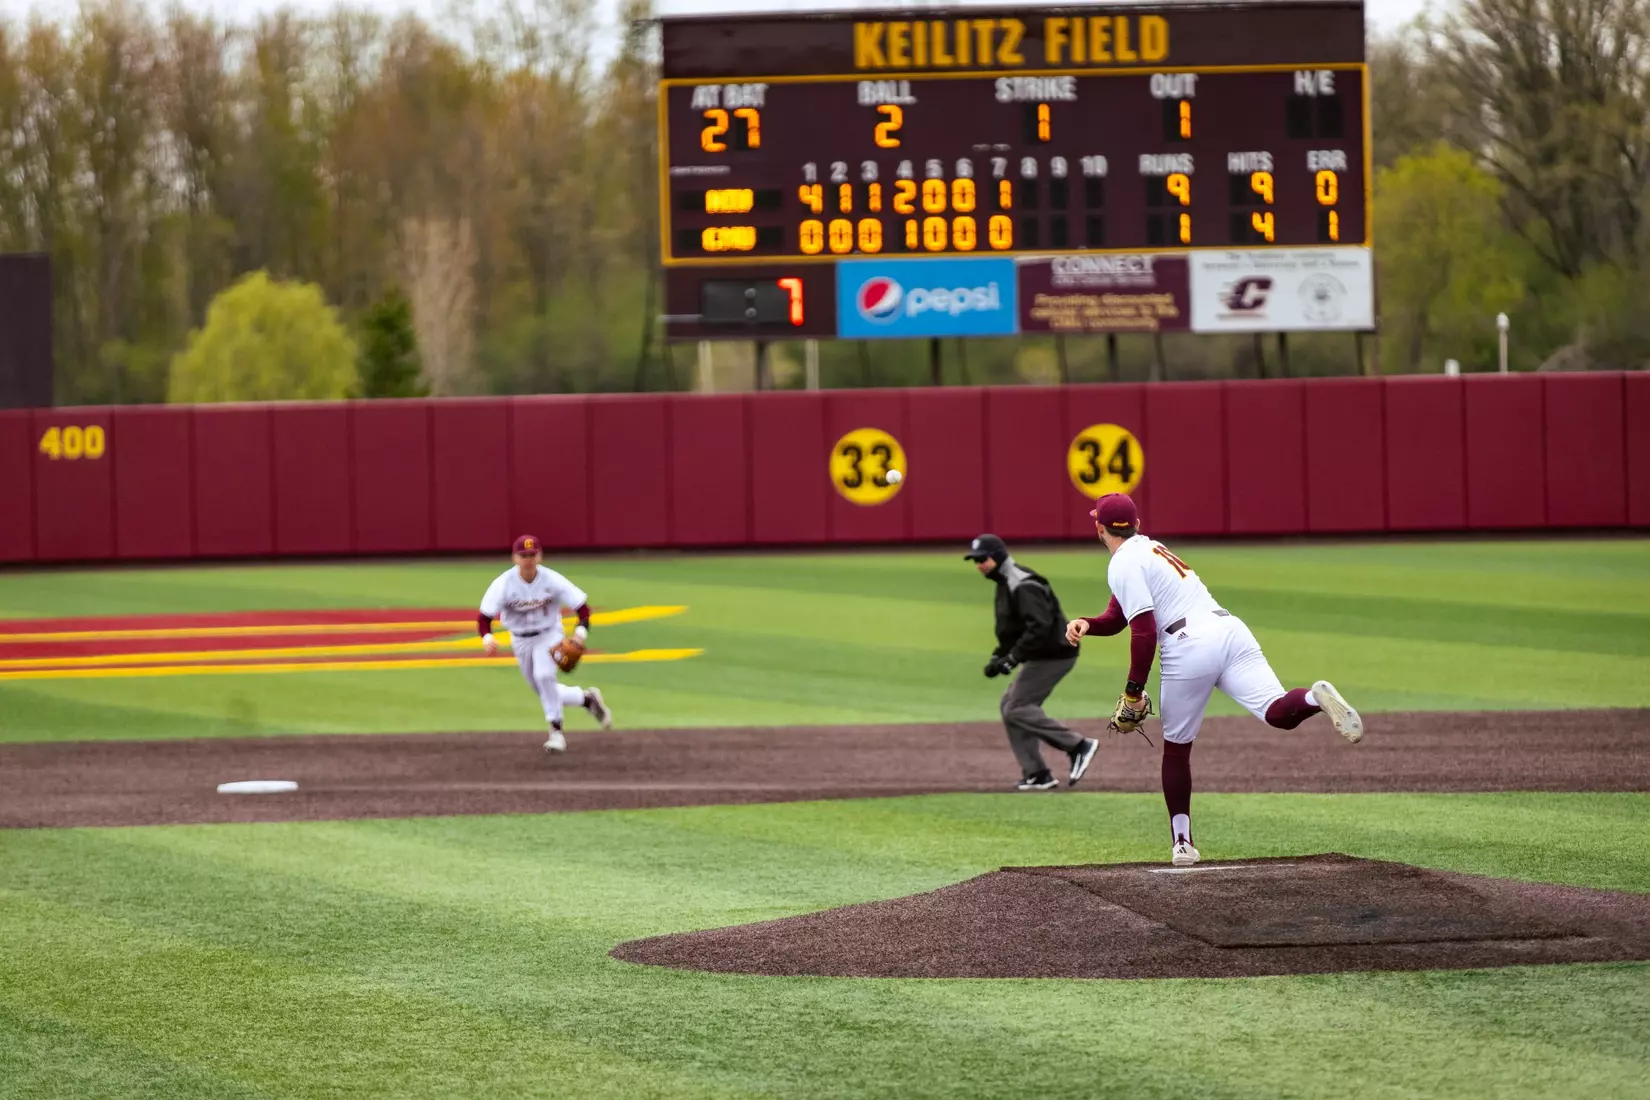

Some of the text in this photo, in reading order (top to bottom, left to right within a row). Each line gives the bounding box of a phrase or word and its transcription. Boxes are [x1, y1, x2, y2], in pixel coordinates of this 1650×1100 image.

[854, 15, 1170, 69] KEILITZ FIELD
[691, 83, 768, 109] AT BAT
[857, 80, 916, 106] BALL
[995, 75, 1077, 102] STRIKE
[1150, 73, 1198, 99] OUT
[701, 108, 761, 152] 27
[874, 104, 903, 148] 2
[1038, 103, 1050, 141] 1
[1179, 101, 1191, 138] 1
[802, 155, 1108, 182] 1 2 3 4 5 6 7 8 9 10
[1139, 149, 1347, 175] RUNS HITS ERR
[799, 170, 1338, 214] 4 1 1 2 0 0 1 9 9 0
[799, 210, 1338, 254] 0 0 0 1 0 0 0 1 4 1
[777, 277, 803, 326] 7
[906, 283, 1000, 317] pepsi
[39, 425, 105, 460] 400
[1078, 437, 1135, 485] 34
[842, 443, 894, 489] 33
